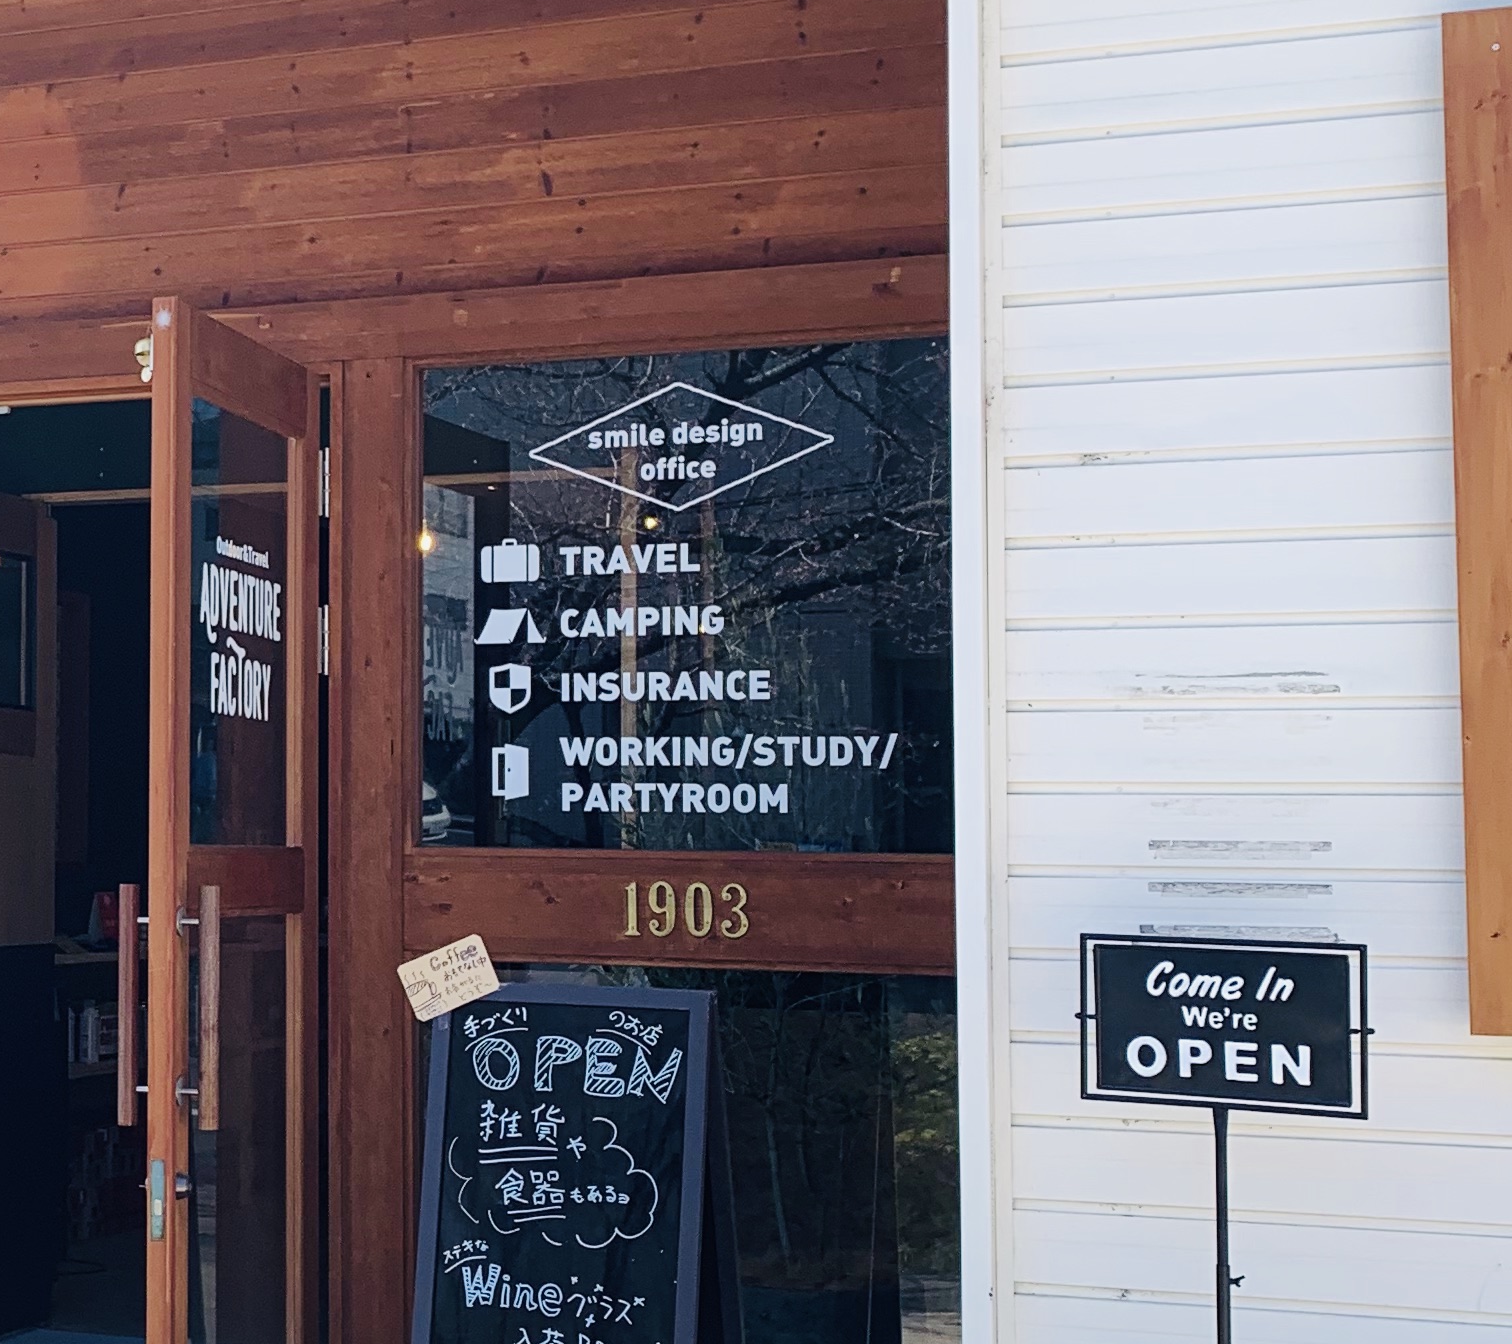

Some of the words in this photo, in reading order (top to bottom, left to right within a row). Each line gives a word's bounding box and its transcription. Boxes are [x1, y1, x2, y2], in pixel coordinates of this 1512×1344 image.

[588, 421, 664, 449] smile
[672, 418, 764, 447] design
[639, 456, 717, 482] office
[559, 543, 701, 577] TRAVEL
[199, 561, 282, 644] ADVENTURE
[559, 605, 725, 639] CAMPING
[210, 636, 272, 722] FACTORY
[560, 669, 772, 703] INSURANCE
[559, 732, 898, 770] WORKING/STUDY/
[560, 781, 790, 815] PARTYROOM
[622, 880, 751, 939] 1903
[429, 944, 479, 972] Coffee
[1146, 960, 1245, 1001] Come
[1255, 965, 1295, 1002] In
[463, 1007, 528, 1037] 手づくり
[608, 1010, 664, 1047] のお店
[1181, 1005, 1258, 1031] We're
[472, 1035, 683, 1104] OPEN
[1126, 1035, 1312, 1087] OPEN
[443, 1239, 489, 1264] ステキな
